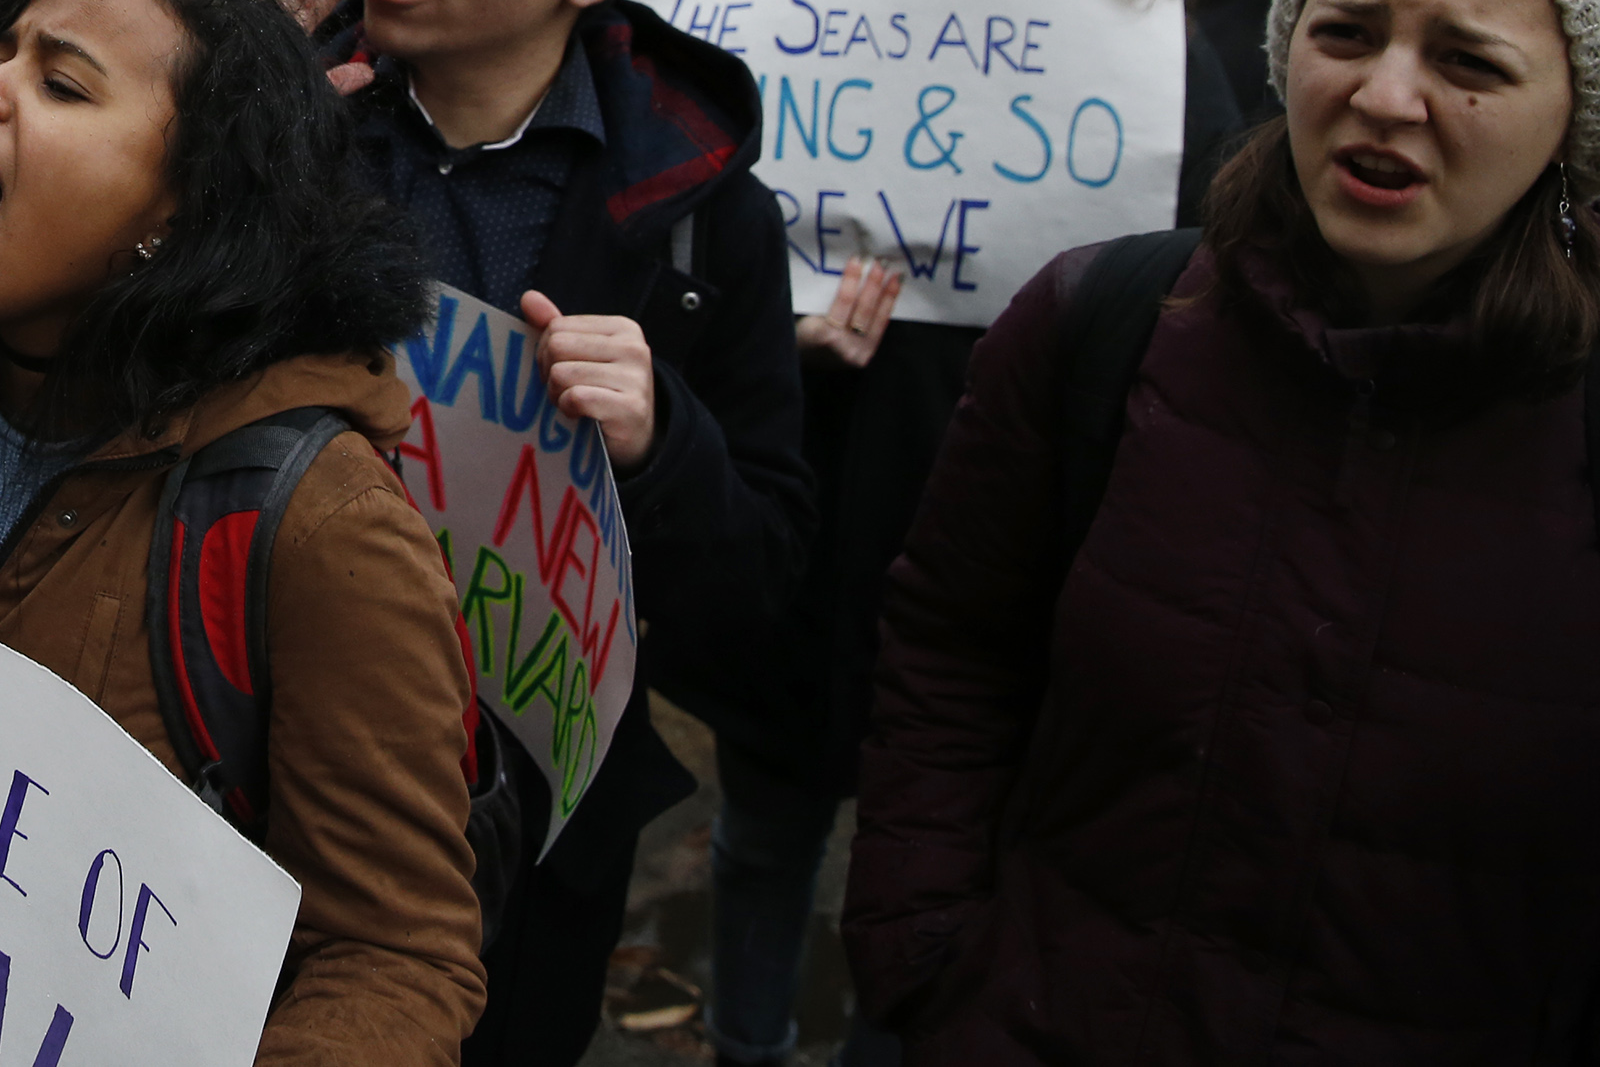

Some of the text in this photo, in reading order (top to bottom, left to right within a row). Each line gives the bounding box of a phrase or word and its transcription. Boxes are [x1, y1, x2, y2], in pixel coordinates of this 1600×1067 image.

[928, 12, 1051, 76] ARE
[760, 73, 1124, 188] NG & SO
[877, 188, 989, 291] WE
[395, 395, 620, 697] A NEW
[436, 526, 597, 819] RVARD
[79, 849, 178, 999] OF
